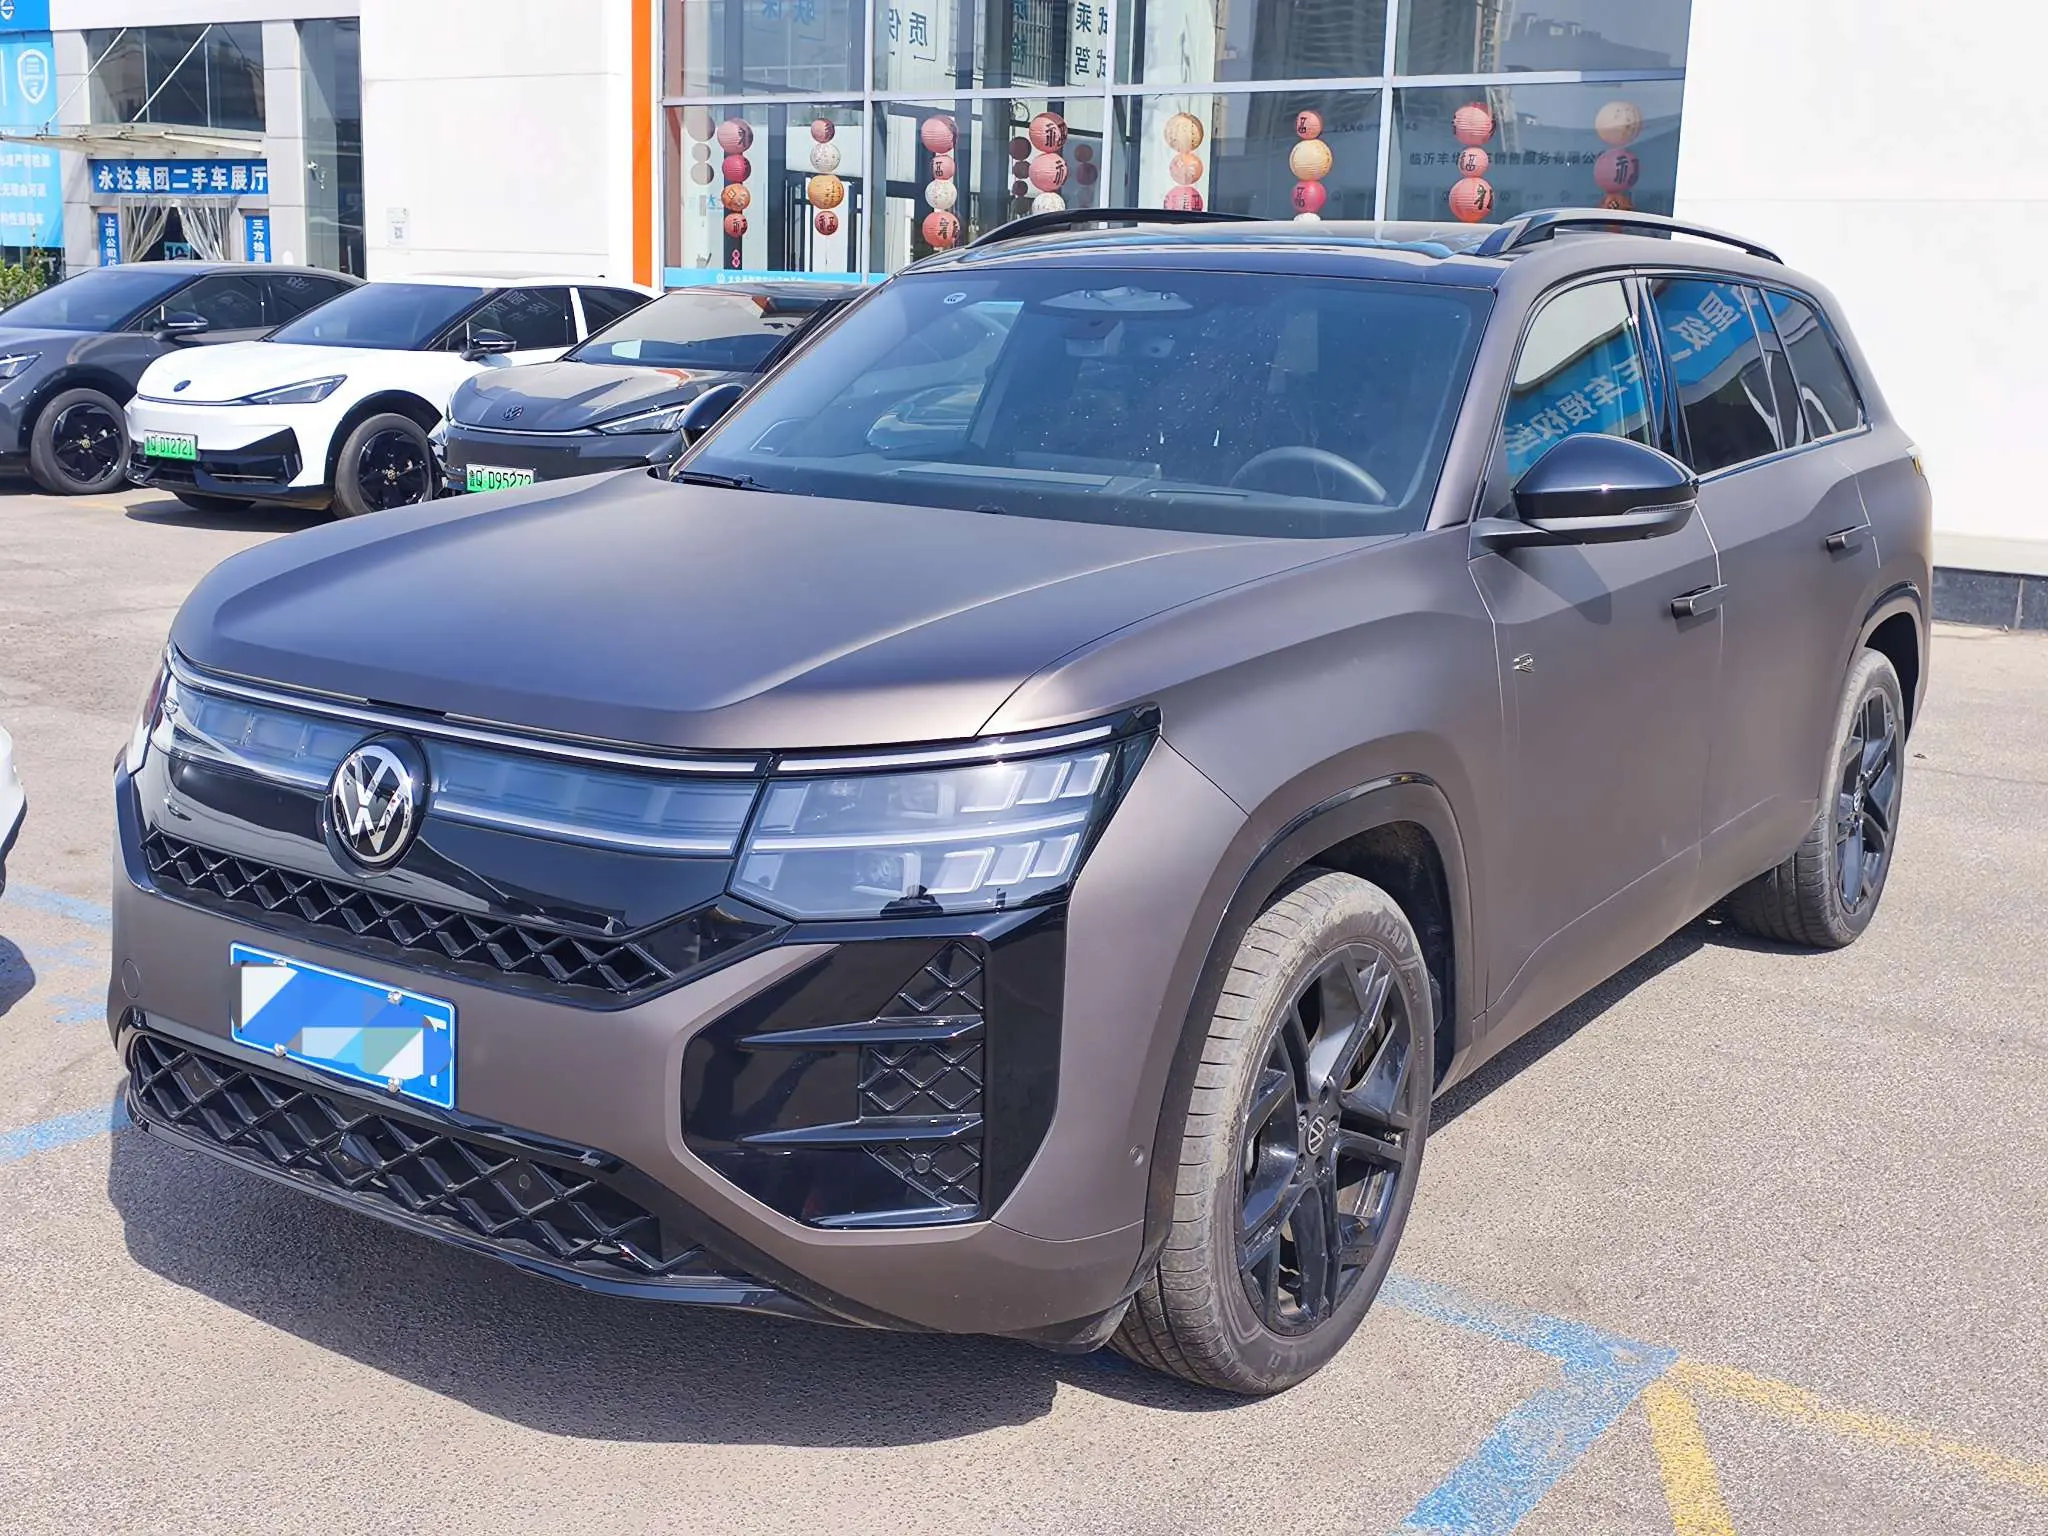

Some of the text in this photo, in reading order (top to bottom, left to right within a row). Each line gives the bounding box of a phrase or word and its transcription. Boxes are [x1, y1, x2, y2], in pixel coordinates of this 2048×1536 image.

[98, 165, 267, 192] 永达集团二手车展厅
